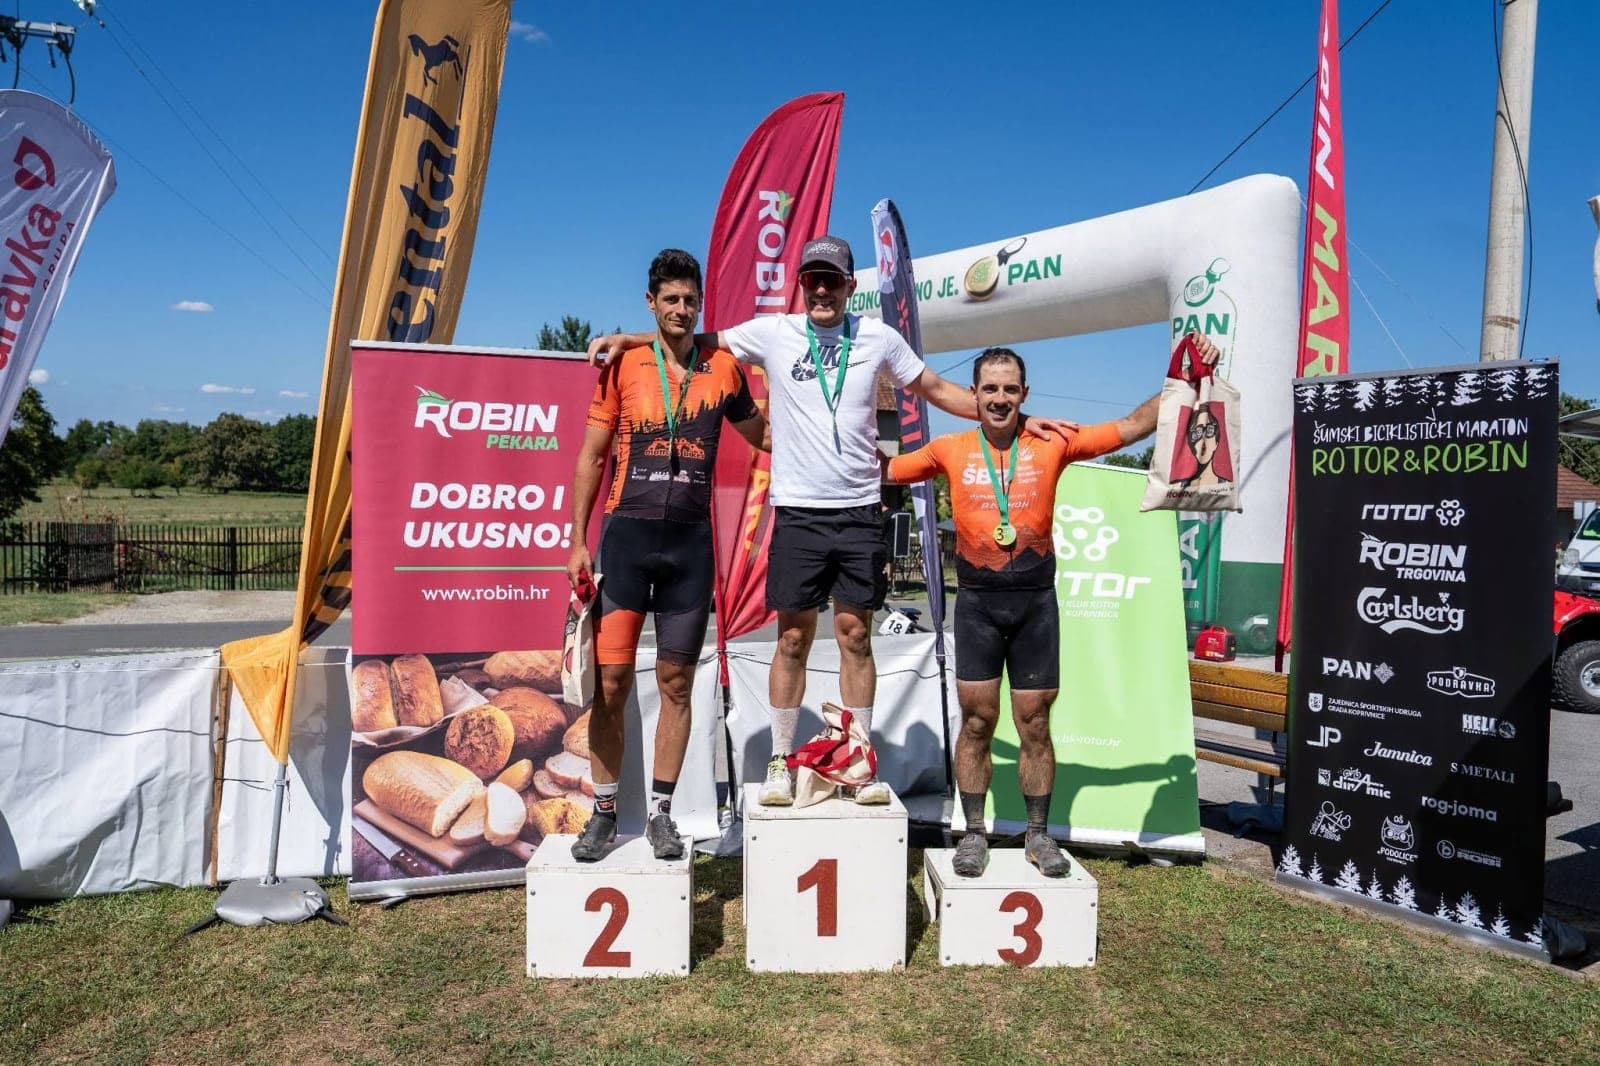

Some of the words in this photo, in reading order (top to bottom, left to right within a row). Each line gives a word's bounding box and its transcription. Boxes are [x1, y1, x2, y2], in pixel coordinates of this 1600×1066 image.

[388, 93, 461, 343] ental
[42, 221, 75, 291] GRUPA
[755, 190, 786, 318] ROBI
[937, 276, 959, 298] JE.
[1008, 254, 1063, 286] PAN
[1303, 202, 1340, 378] MAR
[1173, 312, 1230, 339] PAN
[802, 345, 852, 367] NIK
[414, 401, 559, 438] ROBIN
[1313, 421, 1360, 444] ŠUMSKI
[1363, 407, 1451, 442] BICIKLISTIČKI
[1457, 418, 1528, 437] MARATON
[486, 434, 559, 450] PEKARA
[1312, 440, 1528, 476] ROTOR&ROBIN
[410, 482, 546, 511] DOBRO
[553, 485, 565, 510] I
[403, 521, 573, 548] UKUSNO!
[995, 528, 1004, 541] 3
[1359, 538, 1467, 570] ROBIN
[1396, 567, 1466, 582] TRGOVINA
[421, 585, 550, 601] www.robin.hr
[1357, 587, 1464, 634] Carlsberg
[889, 620, 902, 634] 18
[1322, 657, 1371, 681] PAN
[1431, 676, 1490, 693] PODRAVKA
[1327, 697, 1359, 708] ZAJEDNICA
[1360, 701, 1394, 713] ŠPORTSKIH
[1394, 707, 1422, 718] UDRUGA
[1327, 705, 1348, 713] GRADA
[1348, 709, 1386, 720] KOPRIVNICE
[1363, 741, 1433, 766] Jamnica
[1450, 761, 1459, 773] S
[1460, 763, 1516, 784] METALI
[1421, 795, 1497, 822] rog-joma
[797, 858, 838, 937] 1
[582, 886, 632, 967] 2
[997, 891, 1044, 966] 3
